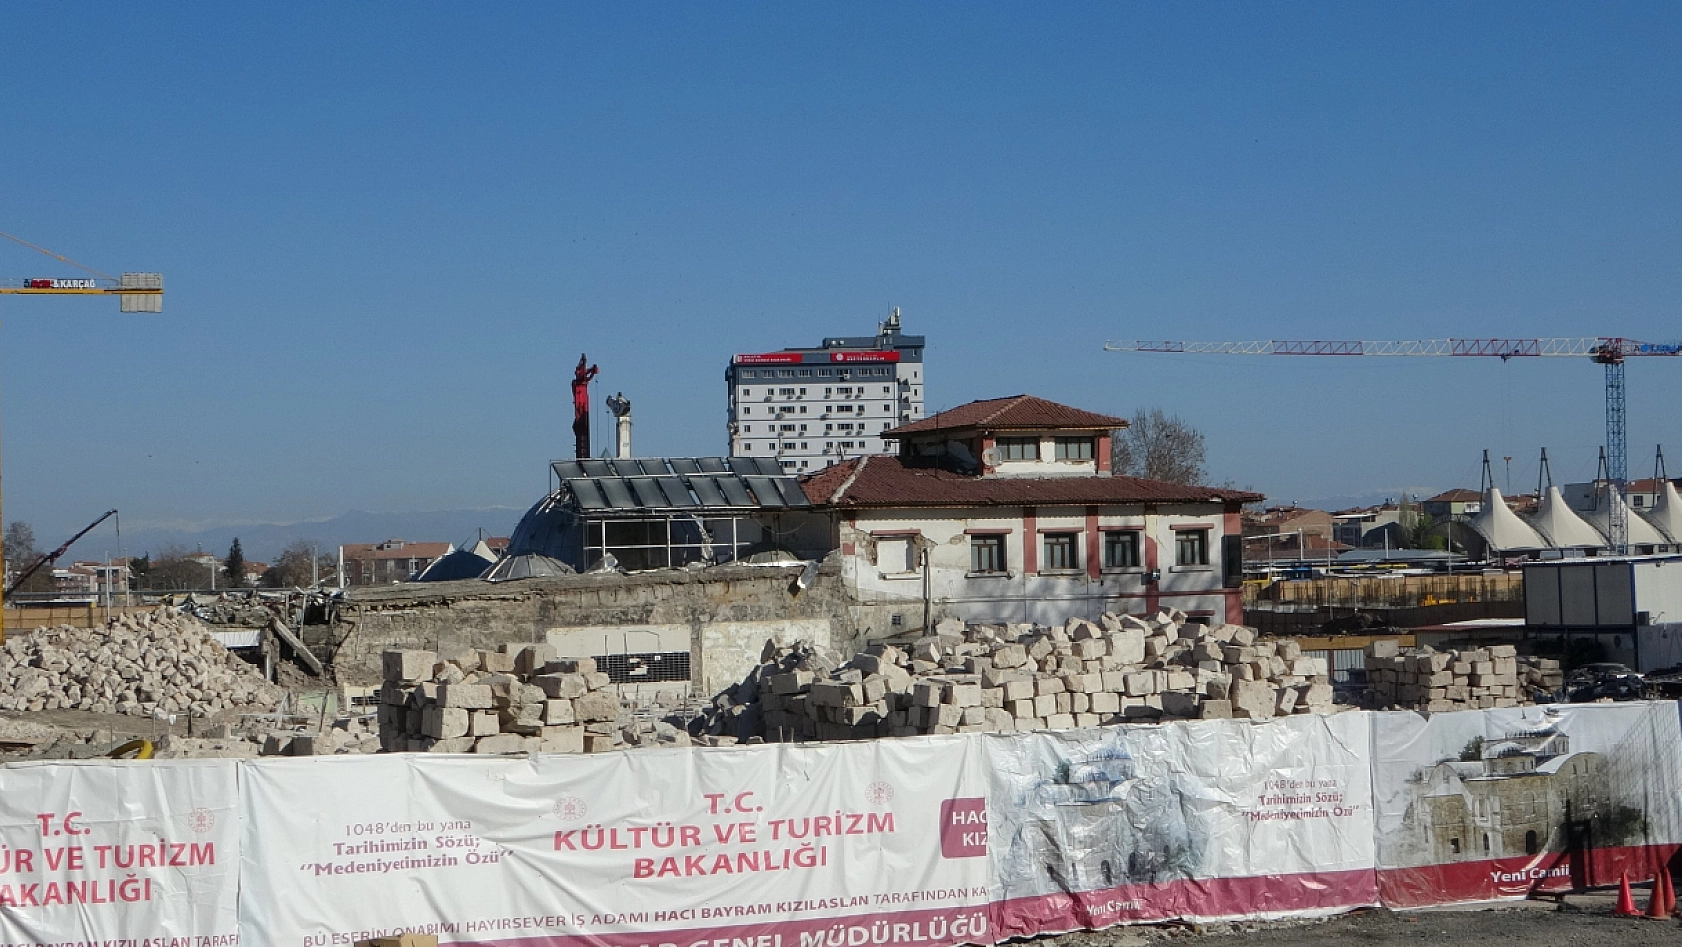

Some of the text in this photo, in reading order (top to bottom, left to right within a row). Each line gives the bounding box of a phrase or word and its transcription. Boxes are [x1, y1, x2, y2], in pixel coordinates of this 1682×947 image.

[704, 791, 764, 815] T.C.
[36, 812, 91, 837] T.C.
[417, 820, 435, 833] bu
[439, 820, 471, 832] yana
[553, 810, 895, 851] KÜLTÜR VE TURİZM
[45, 846, 84, 872] VE
[93, 838, 216, 869] TURİZM
[333, 834, 481, 856] Tarihimizin Sözü;
[633, 842, 827, 879] BAKANLIĞI
[1489, 863, 1570, 883] Yeni Camii
[0, 873, 152, 908] AKANLIĞI
[466, 915, 567, 933] HAYIRSEVER
[590, 911, 650, 926] ADAMI
[654, 909, 696, 922] HACI
[701, 903, 772, 919] BAYRAM
[776, 895, 869, 914] KIZILASLAN
[873, 887, 969, 905] TARAFINDAN
[971, 885, 990, 898] KA
[800, 912, 988, 947] MÜDÜRLÜĞÜ
